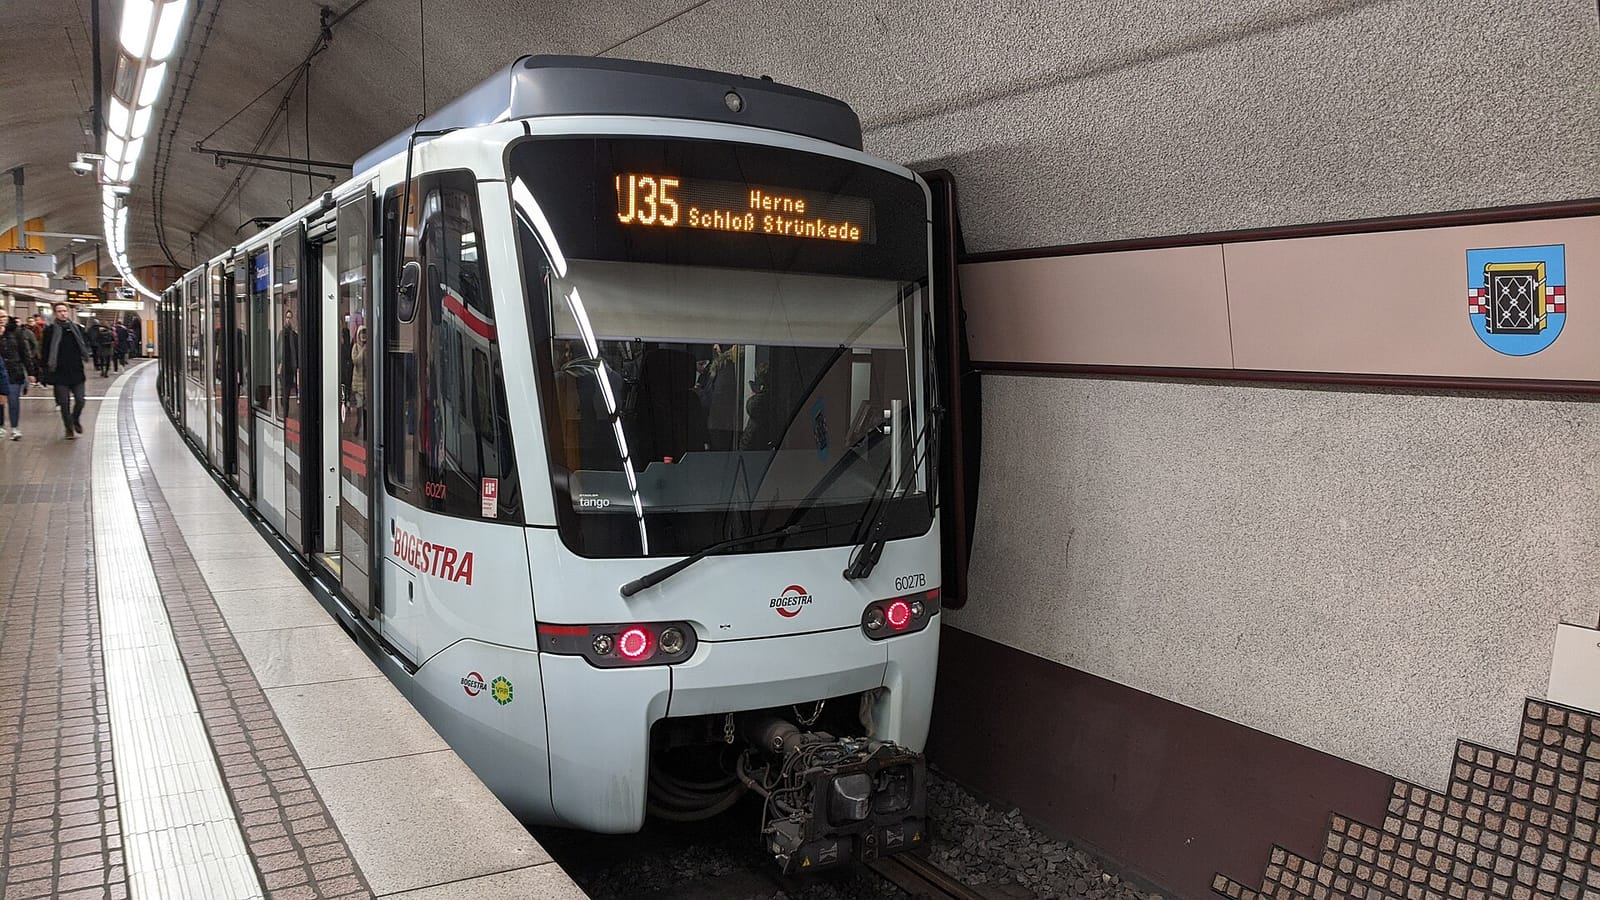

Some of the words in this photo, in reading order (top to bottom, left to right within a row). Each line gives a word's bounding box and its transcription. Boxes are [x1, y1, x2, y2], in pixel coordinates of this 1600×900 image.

[616, 174, 679, 227] U35
[750, 190, 806, 213] Herne
[689, 207, 754, 231] Schloß
[763, 214, 860, 240] Strünkede
[425, 481, 446, 499] 6027
[579, 498, 610, 509] tango
[393, 526, 475, 586] BOGESTRA
[895, 573, 926, 591] 6027B
[769, 594, 813, 608] BOGESTRA
[460, 677, 488, 691] BOGESTRA
